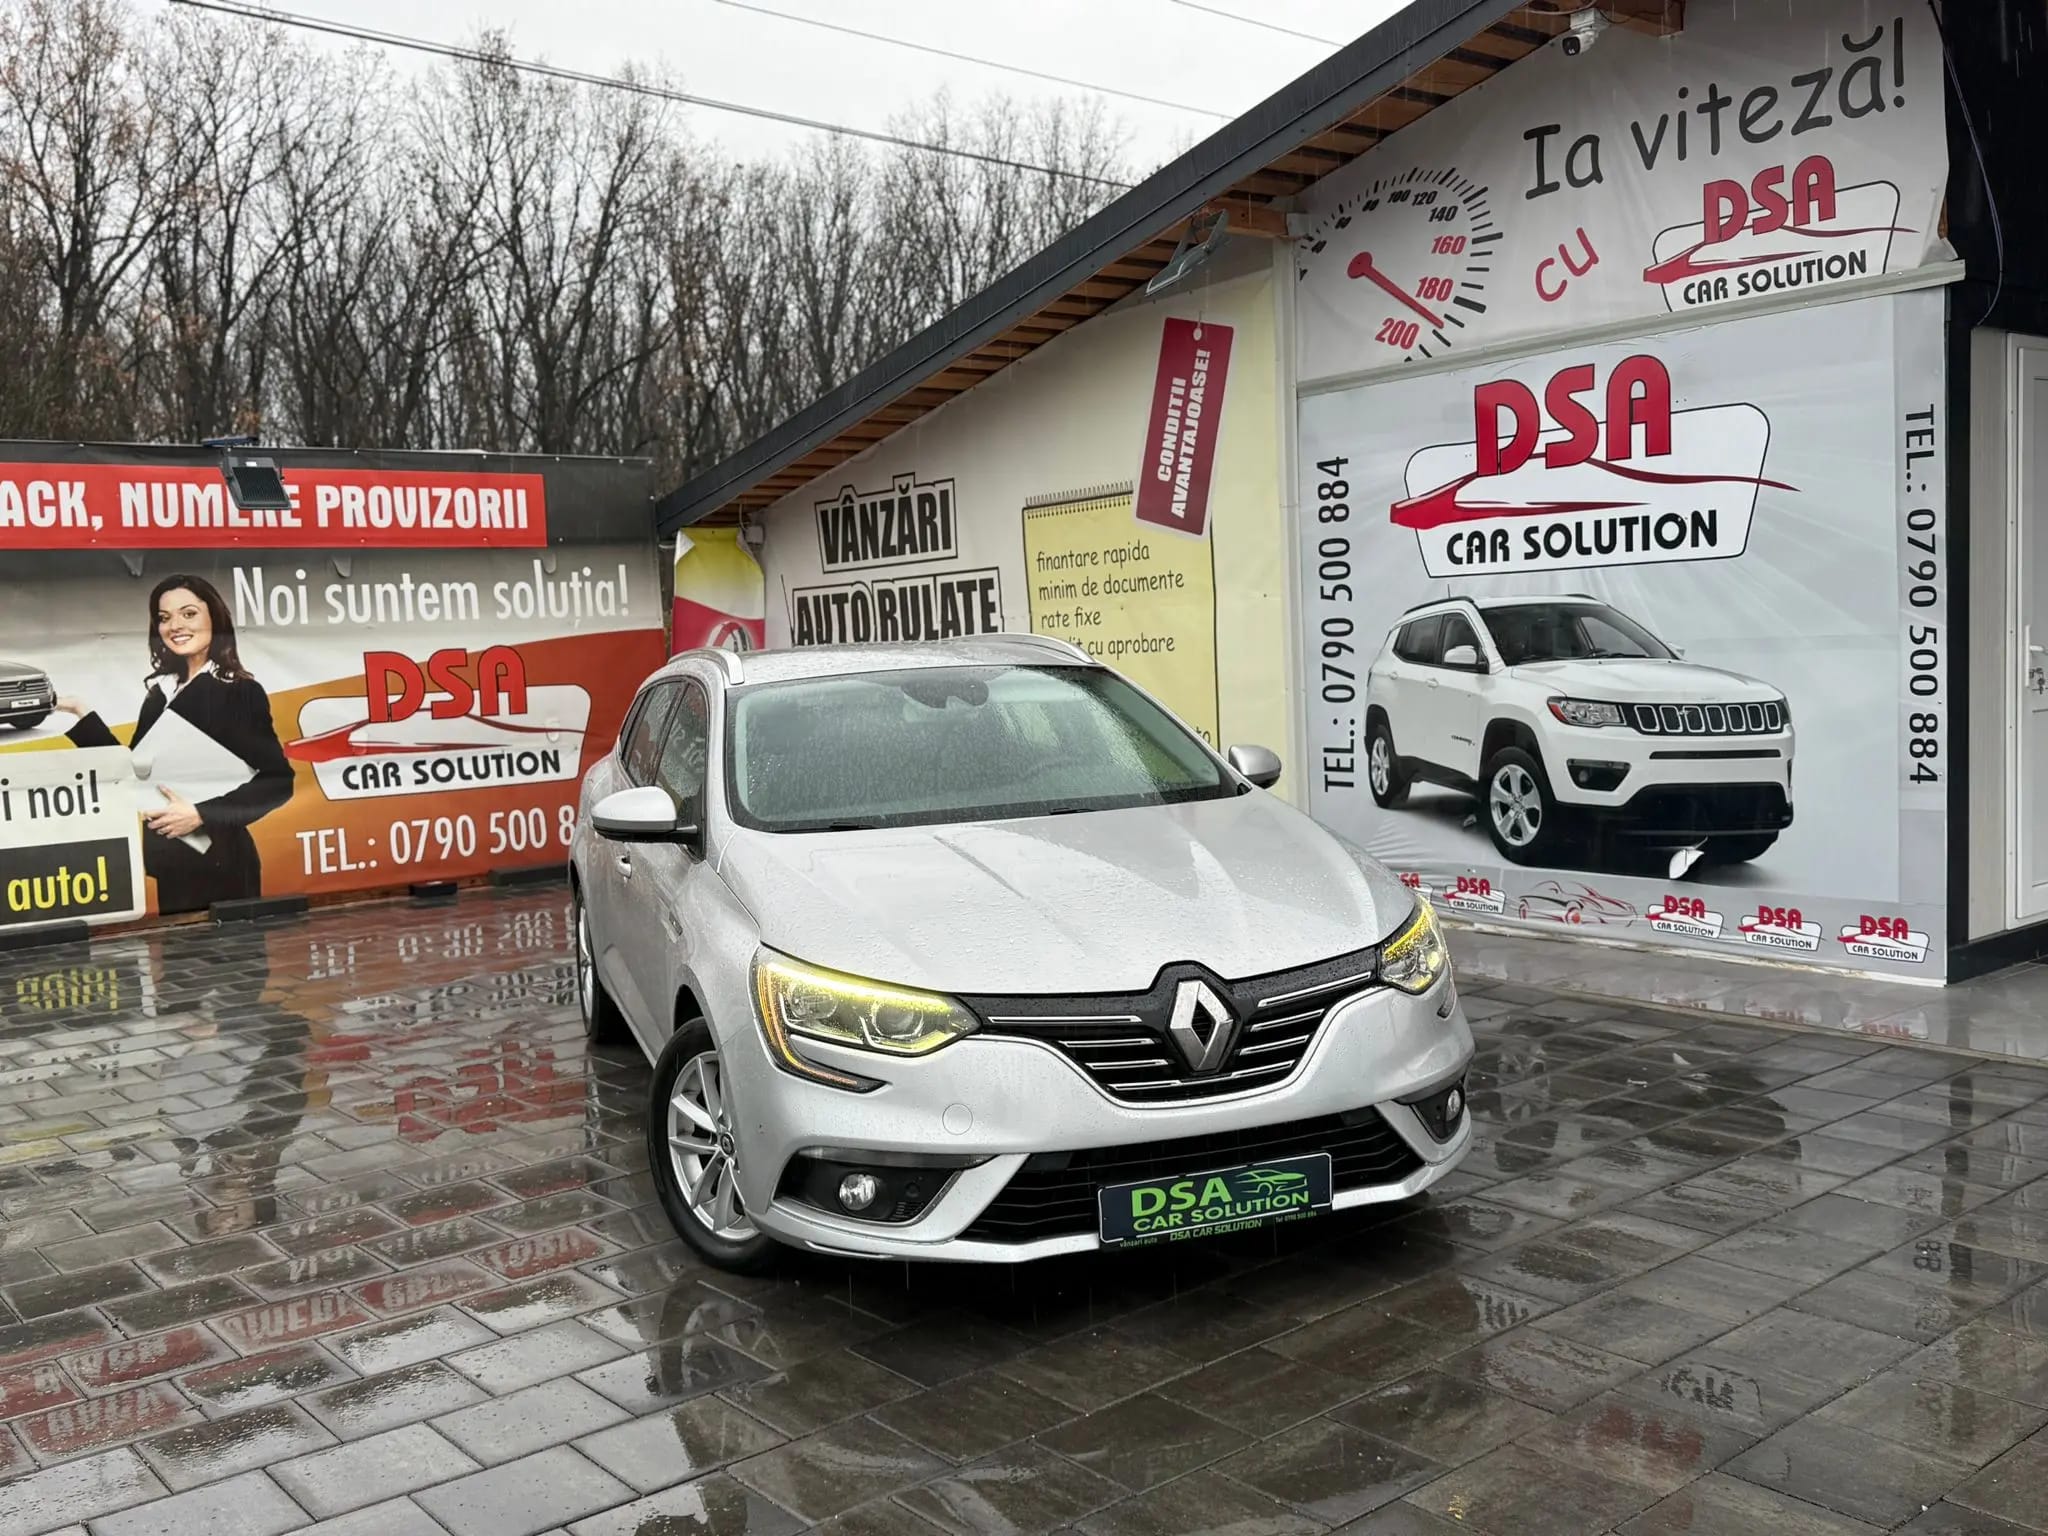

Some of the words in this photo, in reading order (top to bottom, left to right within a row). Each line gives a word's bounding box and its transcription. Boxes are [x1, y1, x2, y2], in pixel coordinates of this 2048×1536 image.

[1523, 123, 1604, 200] Ia
[1630, 17, 1905, 171] viteză!
[1412, 191, 1438, 206] 120
[1428, 205, 1459, 222] 140
[1703, 154, 1836, 245] DSA
[1431, 235, 1467, 255] 160
[1535, 227, 1600, 301] cu
[1415, 276, 1454, 302] 180
[1683, 276, 1729, 305] CAR
[1737, 249, 1867, 297] SOLUTION
[1374, 317, 1420, 350] 200
[1157, 377, 1187, 482] CONDITII
[1171, 349, 1211, 519] AVANTAJOASE!
[1474, 354, 1672, 478] DSA
[1905, 403, 1935, 493] TEL.:
[315, 484, 528, 529] PROVIZORII
[1316, 456, 1350, 524] 884
[820, 483, 952, 565] VÂNZĂRI
[1446, 528, 1511, 566] CAR
[1523, 509, 1718, 561] SOLUTION
[1036, 550, 1099, 573] finantare
[1103, 539, 1150, 569] rapida
[1318, 537, 1353, 602] 500
[1906, 508, 1938, 608] 0790
[232, 566, 309, 627] Noi
[324, 573, 480, 624] suntem
[494, 559, 630, 629] soluția!
[1039, 579, 1077, 600] minim
[1082, 576, 1099, 597] de
[1103, 569, 1184, 595] documente
[1041, 610, 1070, 629] rate
[1074, 606, 1102, 628] fixe
[1088, 641, 1104, 656] cu
[1107, 632, 1176, 660] aprobare
[1321, 617, 1356, 704] 0790
[1908, 624, 1938, 697] 500
[363, 645, 528, 723] DSA
[342, 762, 402, 790] CAR
[412, 750, 561, 785] SOLUTION
[1323, 717, 1356, 793] TEL.:
[1909, 712, 1939, 784] 884
[27, 769, 101, 819] noi!
[296, 828, 377, 875] TEL.:
[389, 815, 476, 865] 0790
[489, 807, 547, 854] 500
[7, 856, 109, 912] auto!
[1397, 872, 1420, 888] SA
[1456, 876, 1491, 896] DSA
[1466, 902, 1499, 912] SOLUTION
[1657, 921, 1672, 931] CAR
[1674, 923, 1714, 937] SOLUTION
[1664, 894, 1705, 919] DSA
[1758, 905, 1802, 930] DSA
[1860, 914, 1909, 940] DSA
[1751, 934, 1768, 944] CAR
[1769, 936, 1812, 949] SOLUTION
[1852, 944, 1870, 955] CAR
[1872, 947, 1918, 961] SOLUTION
[1131, 1176, 1233, 1218] DSA
[1133, 1213, 1184, 1232] CAR
[1190, 1191, 1309, 1223] SOLUTION
[1169, 1229, 1191, 1242] DSA
[1192, 1225, 1213, 1238] CAR
[1214, 1218, 1263, 1235] SOLUTION
